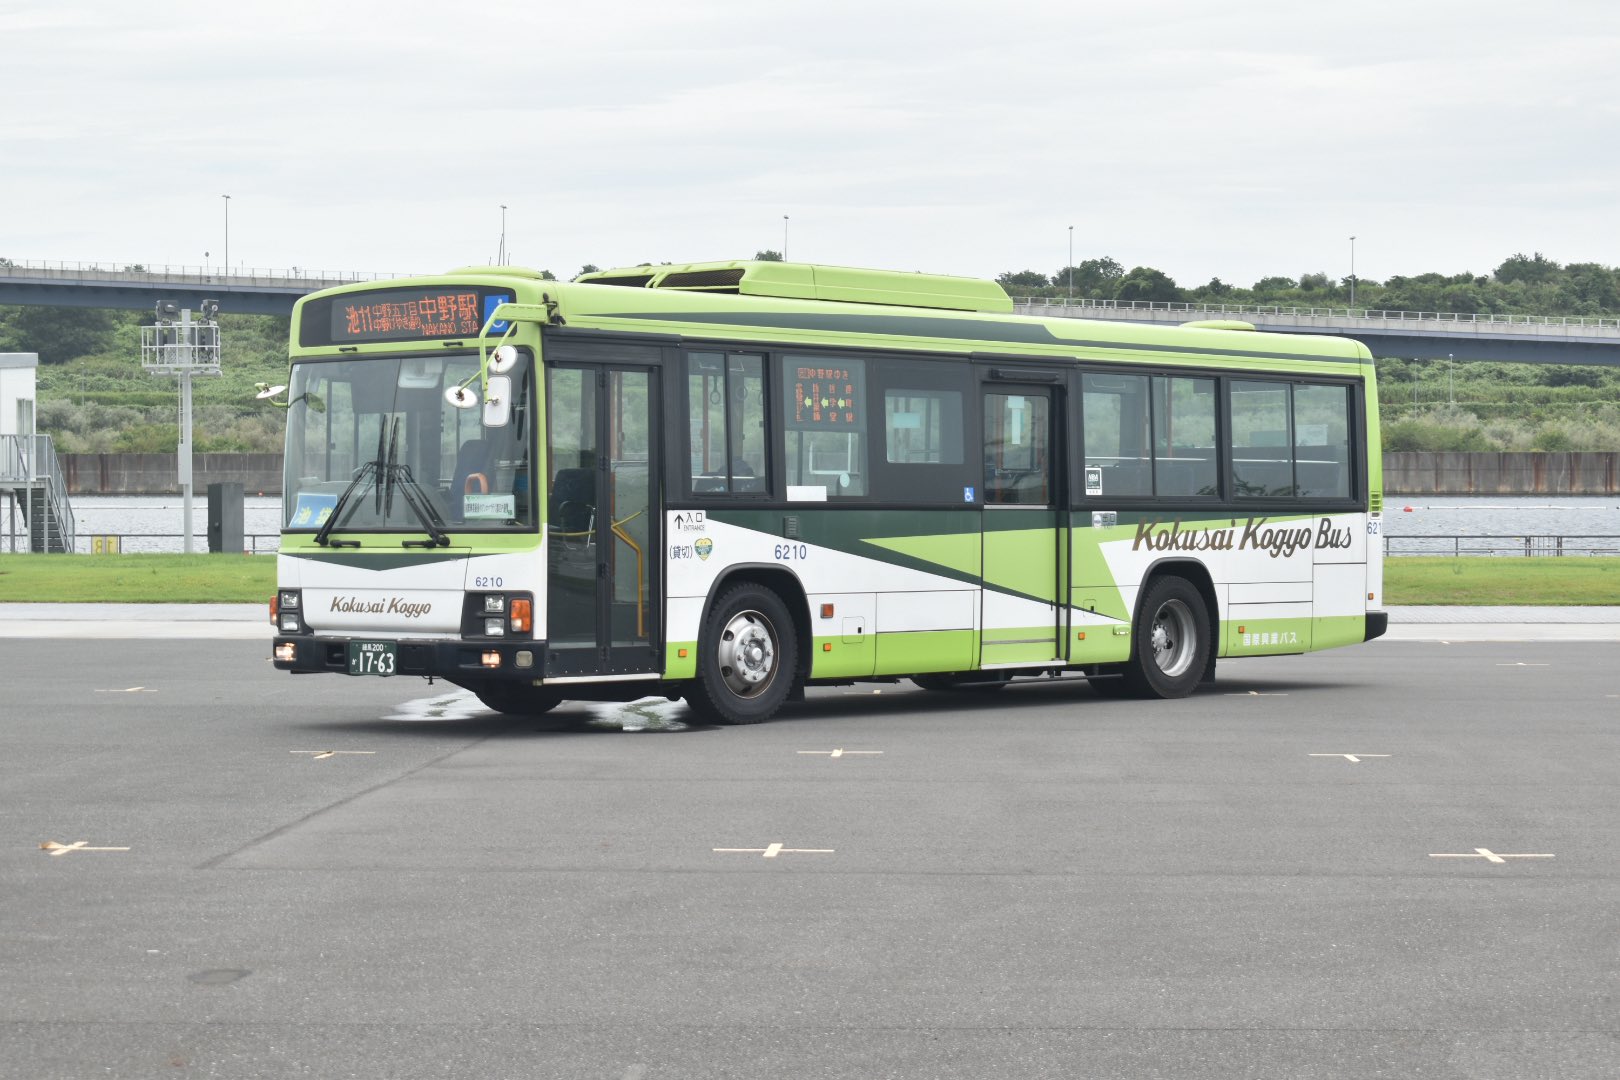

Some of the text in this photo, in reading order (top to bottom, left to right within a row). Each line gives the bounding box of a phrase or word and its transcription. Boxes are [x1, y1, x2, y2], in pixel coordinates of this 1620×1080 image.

[418, 293, 479, 322] 中野駅
[421, 320, 479, 336] NAKANO STA
[685, 512, 703, 523] 入口
[683, 524, 705, 532] ENTRANCE
[1131, 516, 1236, 552] Kokusai
[1238, 517, 1312, 559] Kogyo
[1314, 517, 1352, 549] Bus
[774, 544, 807, 560] 6210
[475, 575, 503, 588] 6210
[329, 595, 432, 619] Kokusai Kogyo
[372, 643, 384, 651] 200
[1242, 632, 1297, 647] 国際興業バス
[359, 651, 395, 673] 17-63
